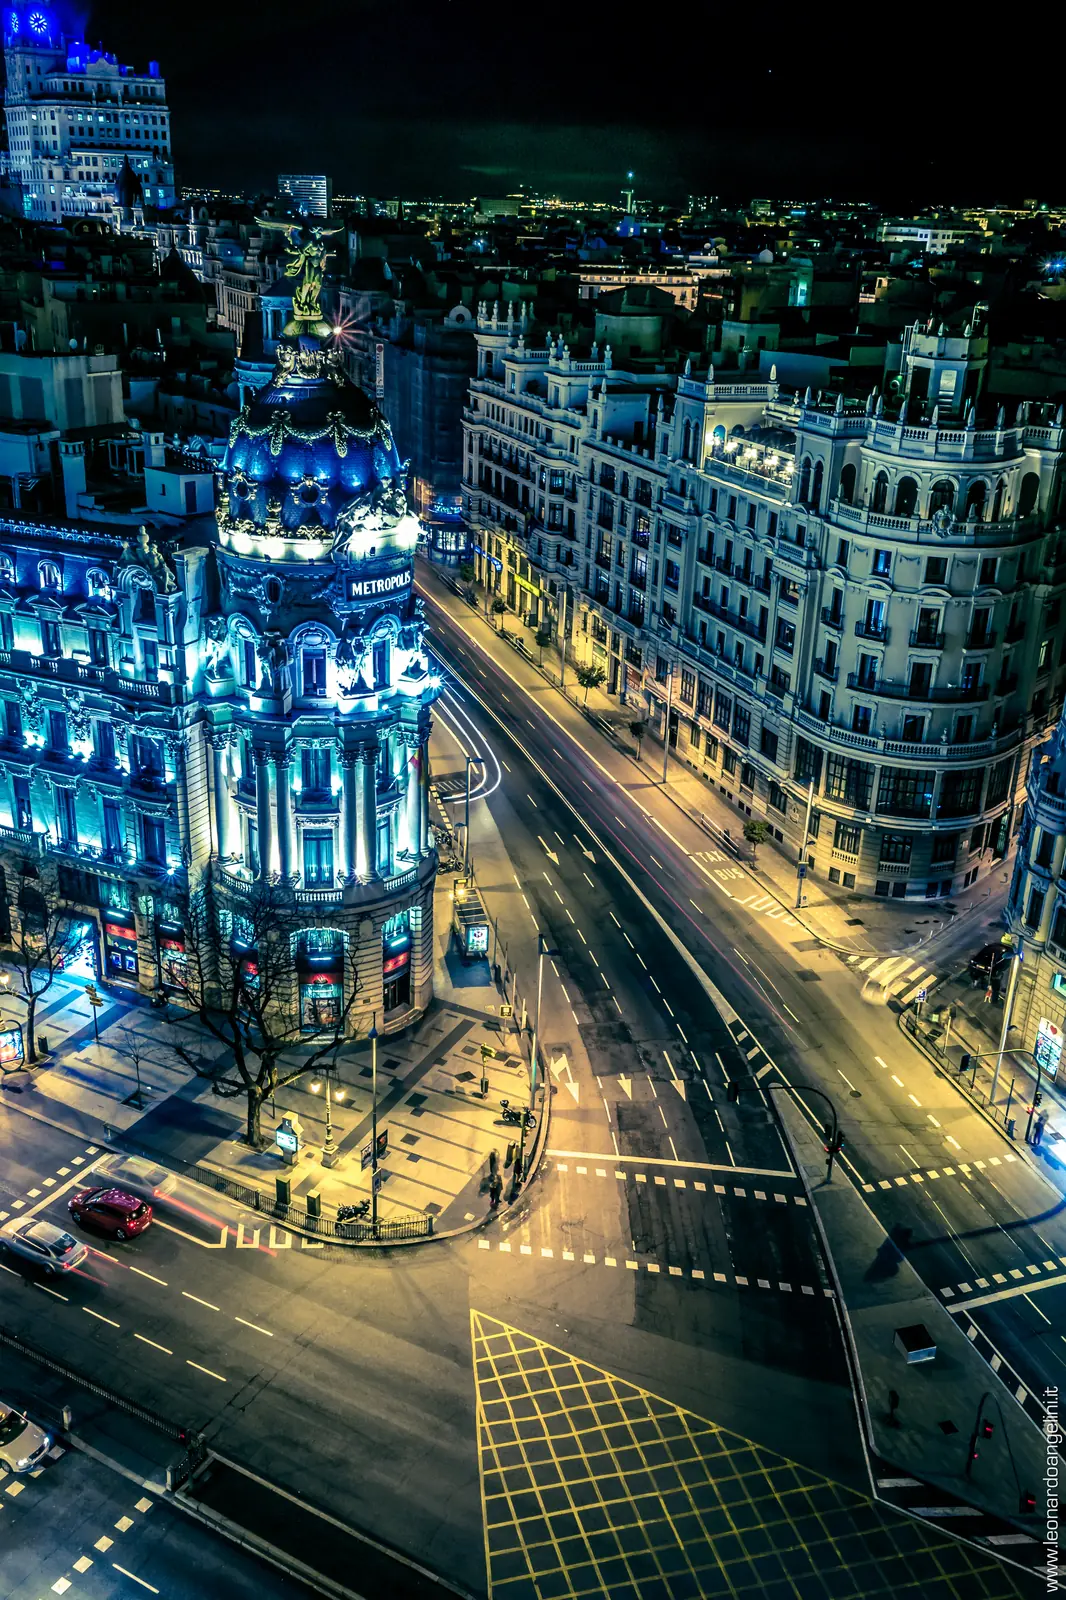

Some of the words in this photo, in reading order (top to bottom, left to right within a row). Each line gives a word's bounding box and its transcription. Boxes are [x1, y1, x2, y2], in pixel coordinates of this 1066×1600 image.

[352, 570, 411, 596] METROPOLIS
[695, 850, 731, 863] TAXI
[713, 867, 745, 881] BUS
